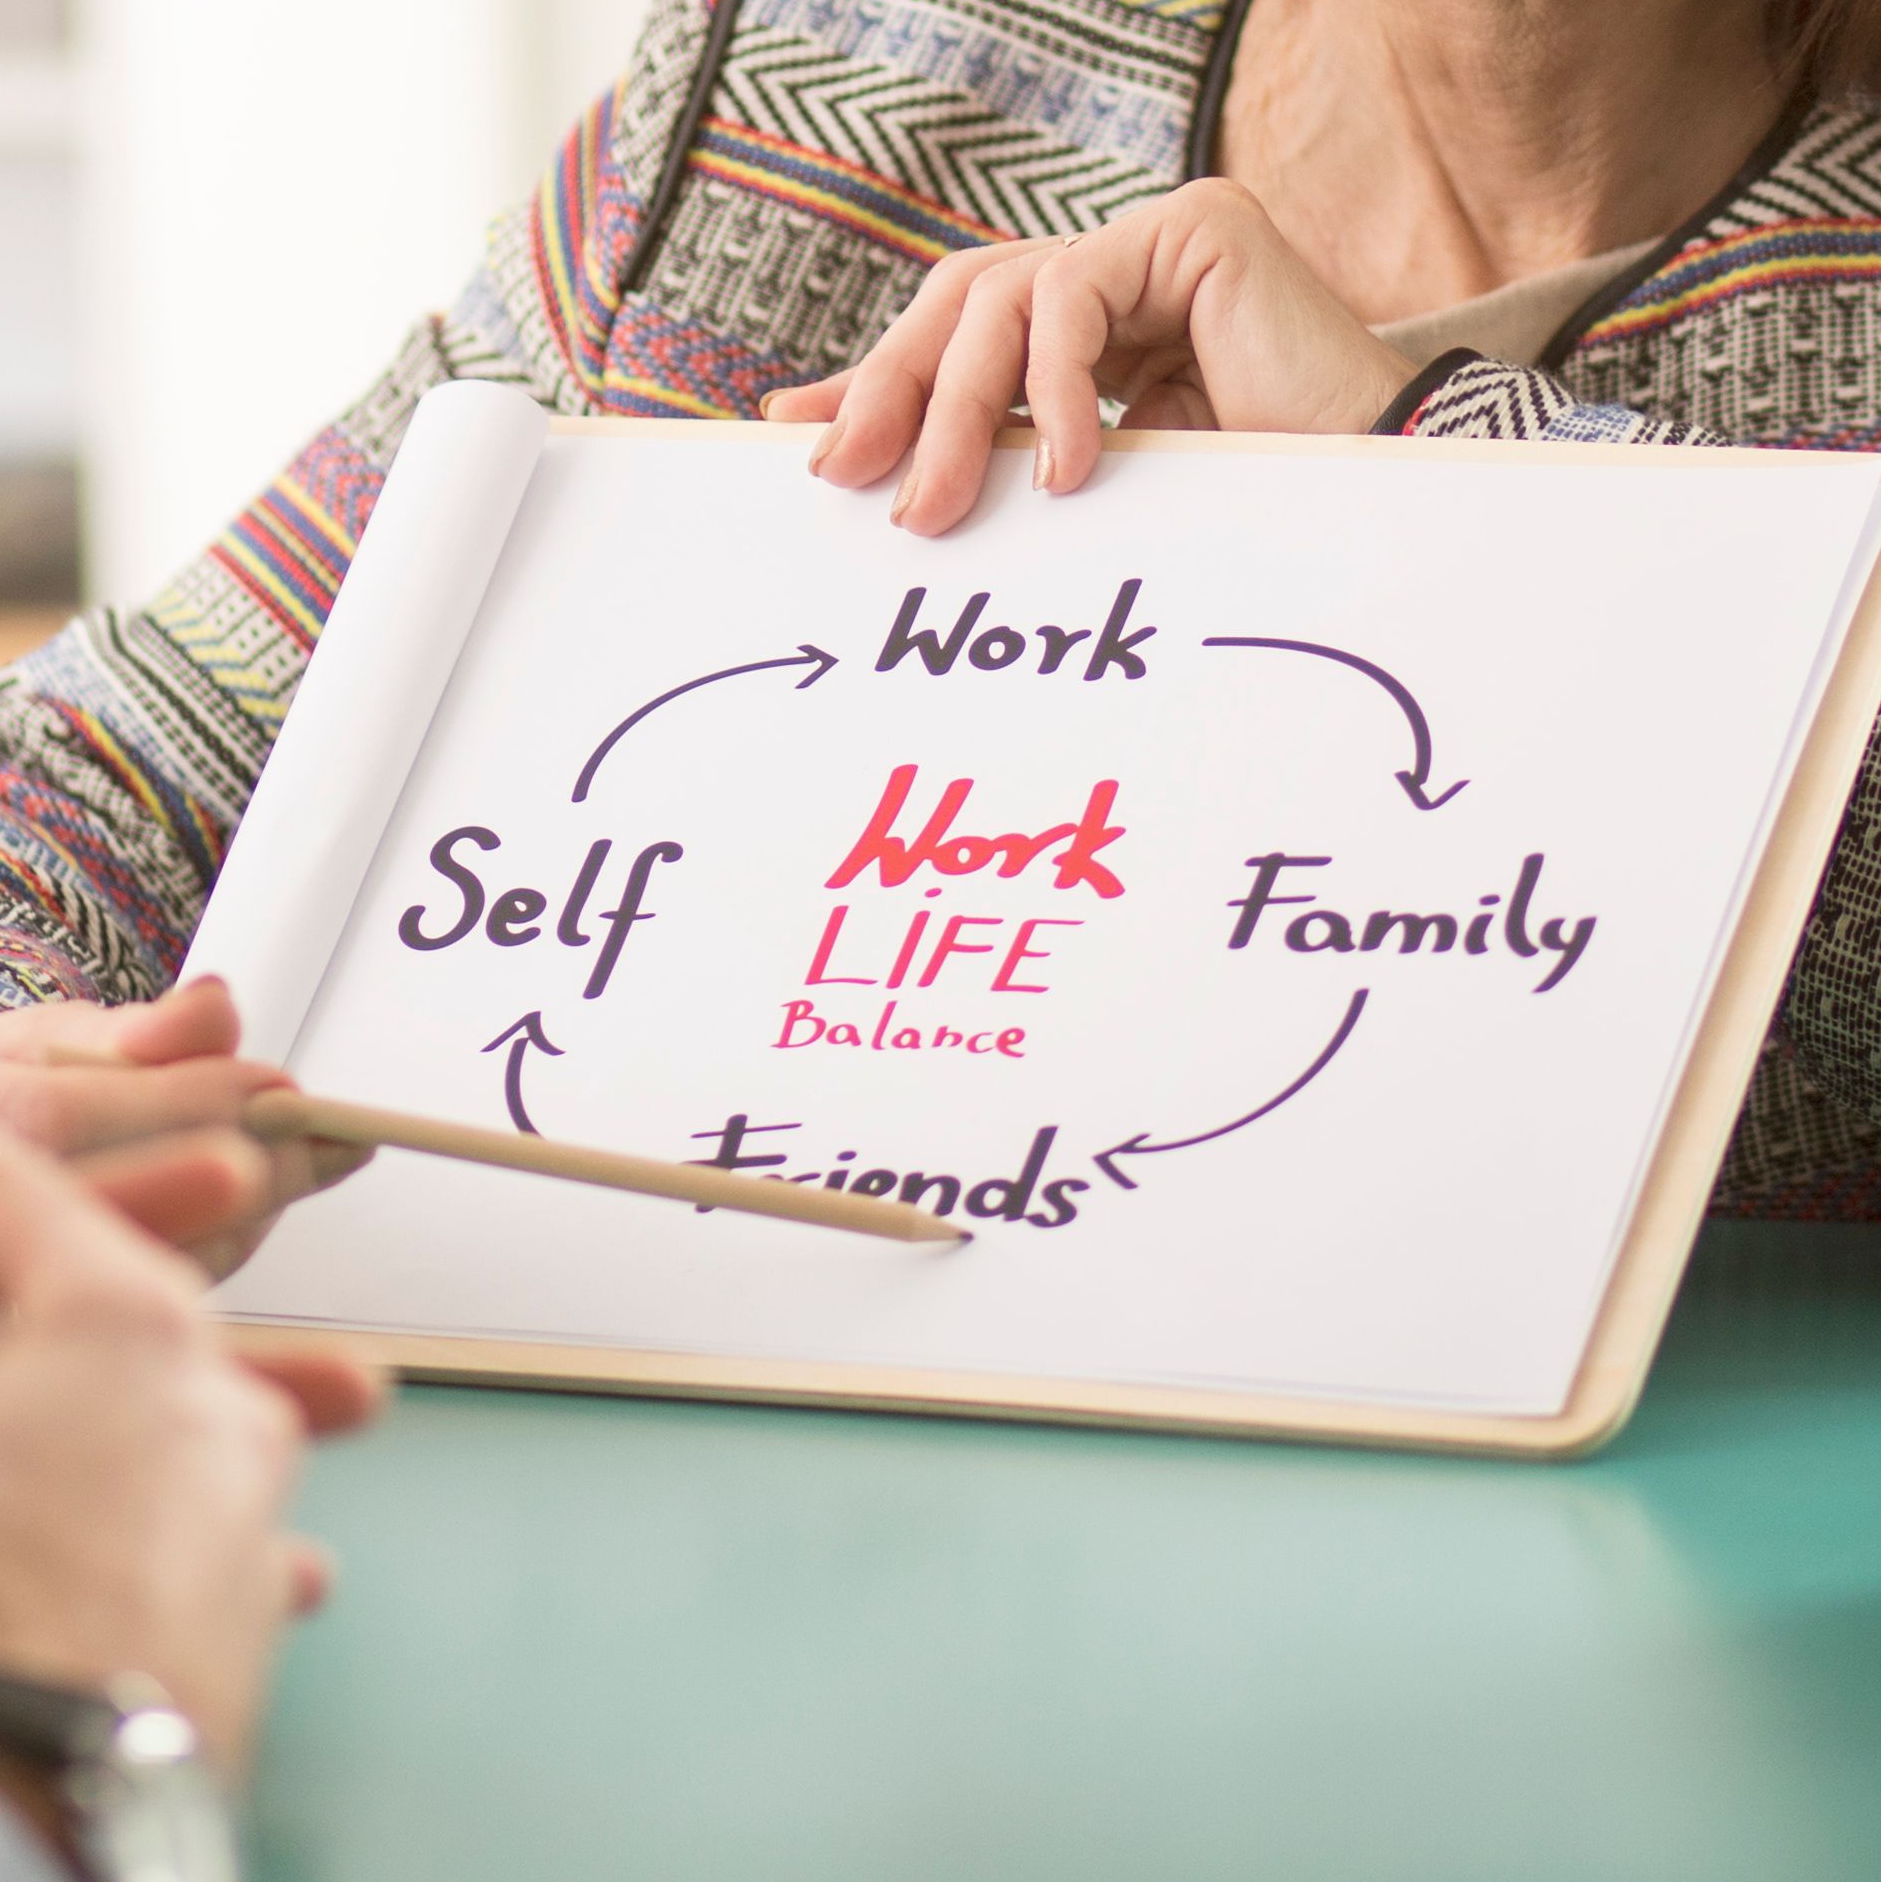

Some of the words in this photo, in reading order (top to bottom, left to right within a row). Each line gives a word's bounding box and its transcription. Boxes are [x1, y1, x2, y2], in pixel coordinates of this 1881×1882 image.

[874, 578, 1158, 682] Work
[824, 763, 1127, 900] Work
[398, 824, 685, 1001] Self
[1225, 852, 1599, 995] Family
[772, 999, 1027, 1060] Balance
